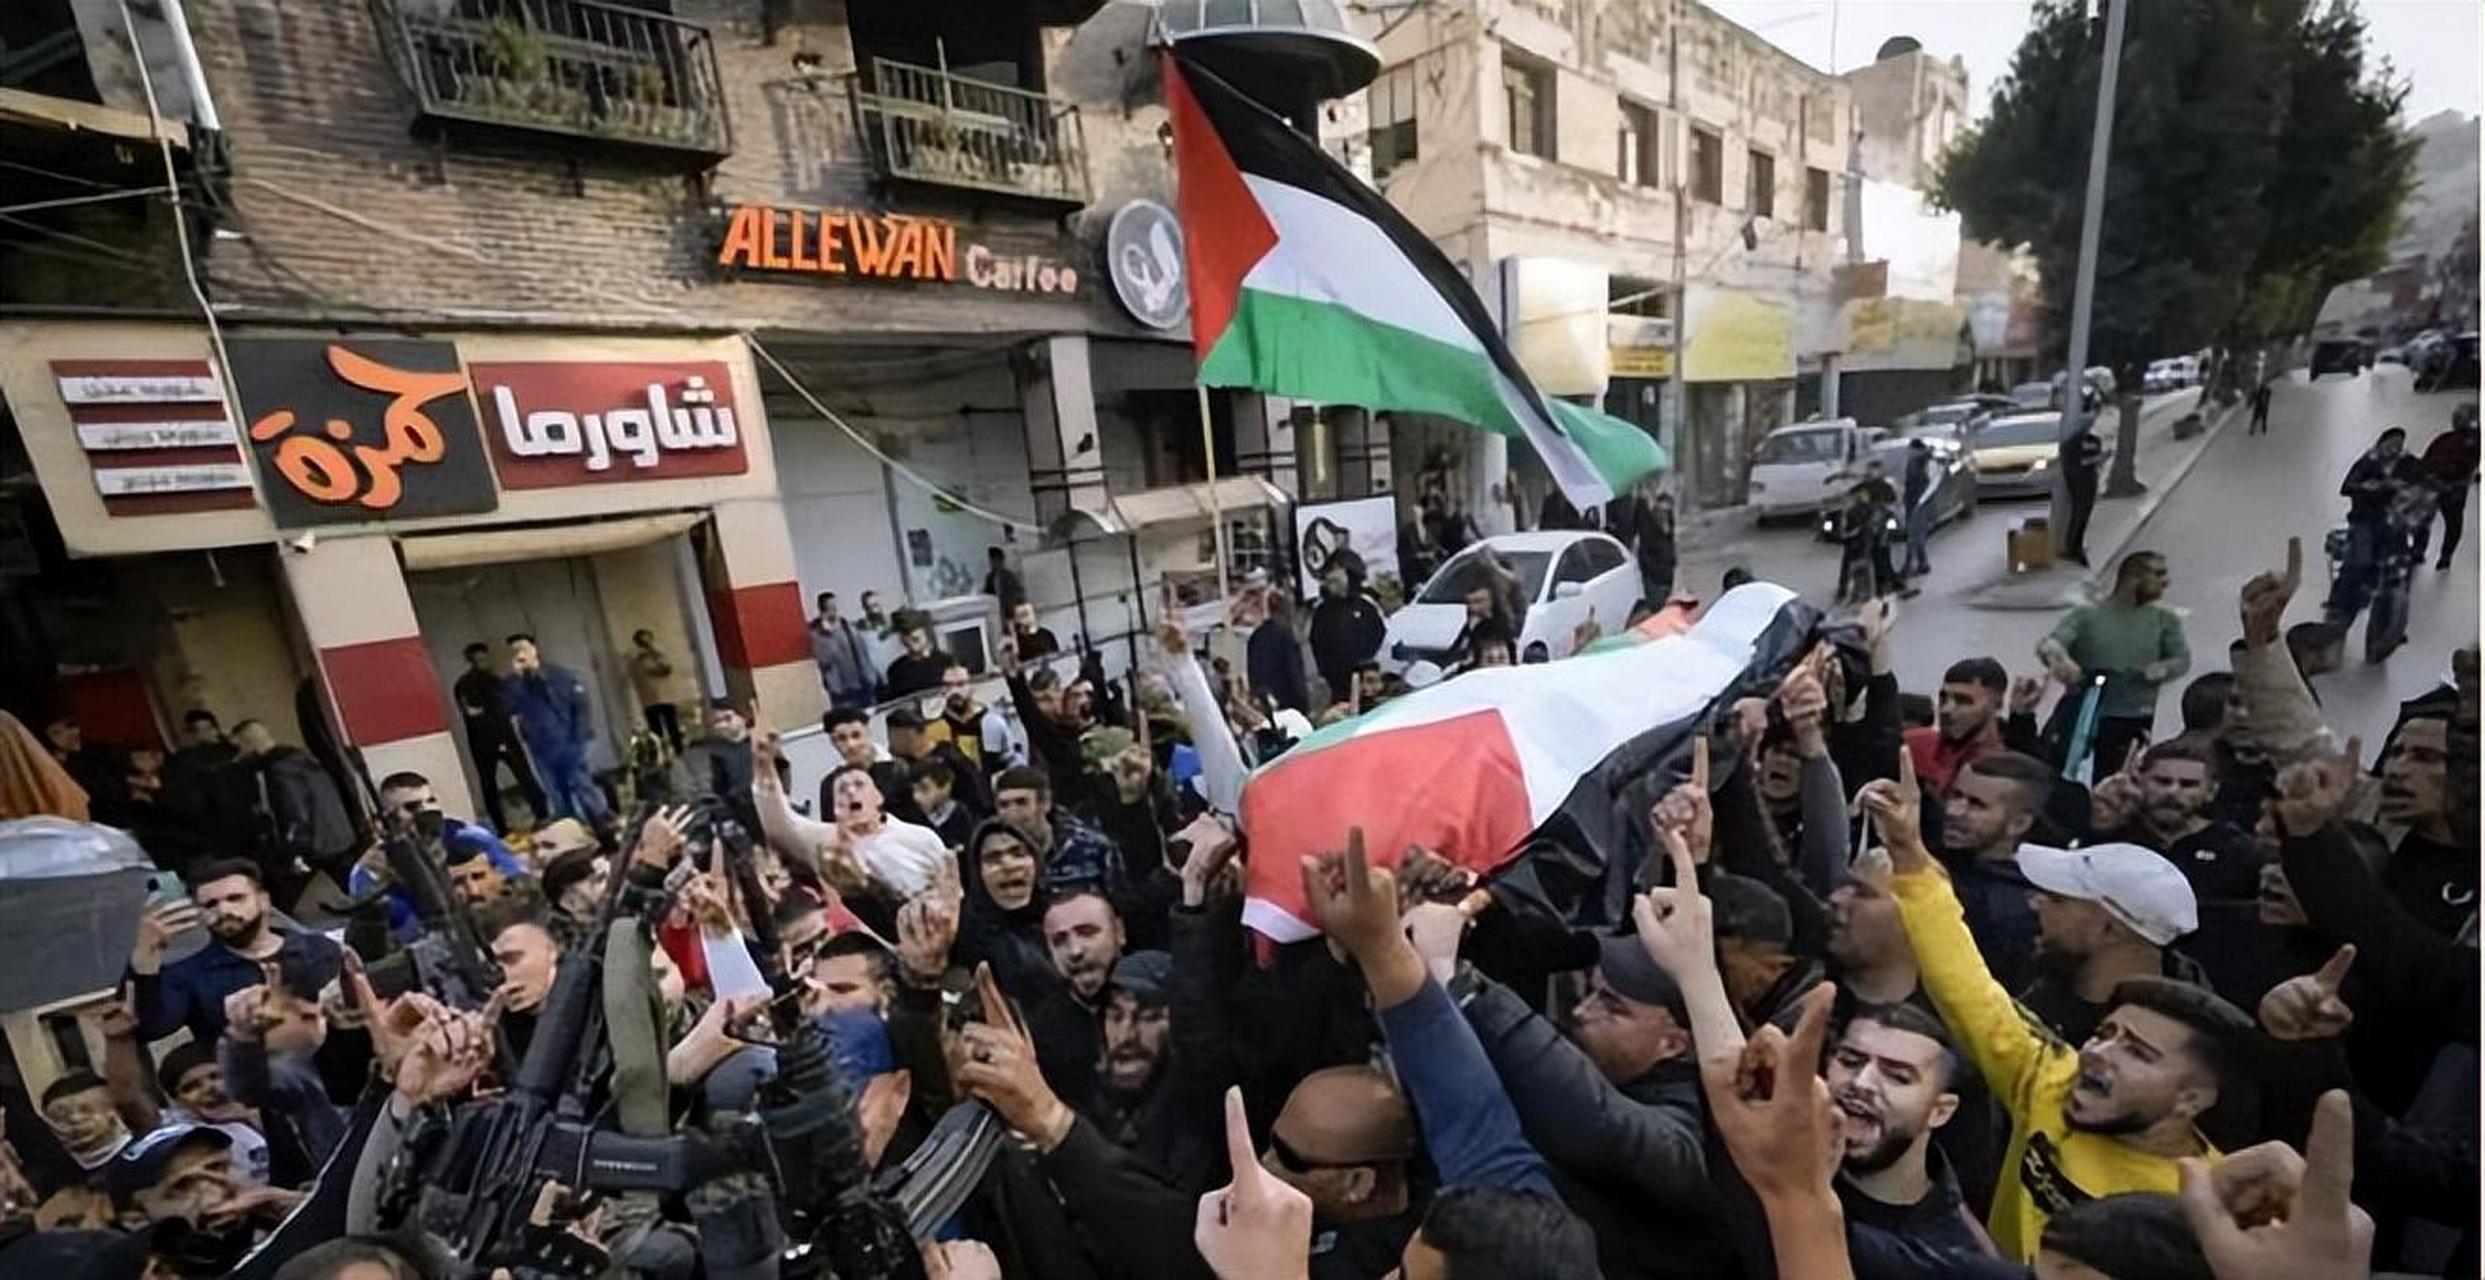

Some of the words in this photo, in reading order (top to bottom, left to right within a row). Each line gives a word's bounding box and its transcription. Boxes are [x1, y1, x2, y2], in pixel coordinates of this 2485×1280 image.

[719, 205, 955, 282] ALLEWAN
[251, 345, 469, 508] حمزة
[494, 375, 737, 471] شاورما
